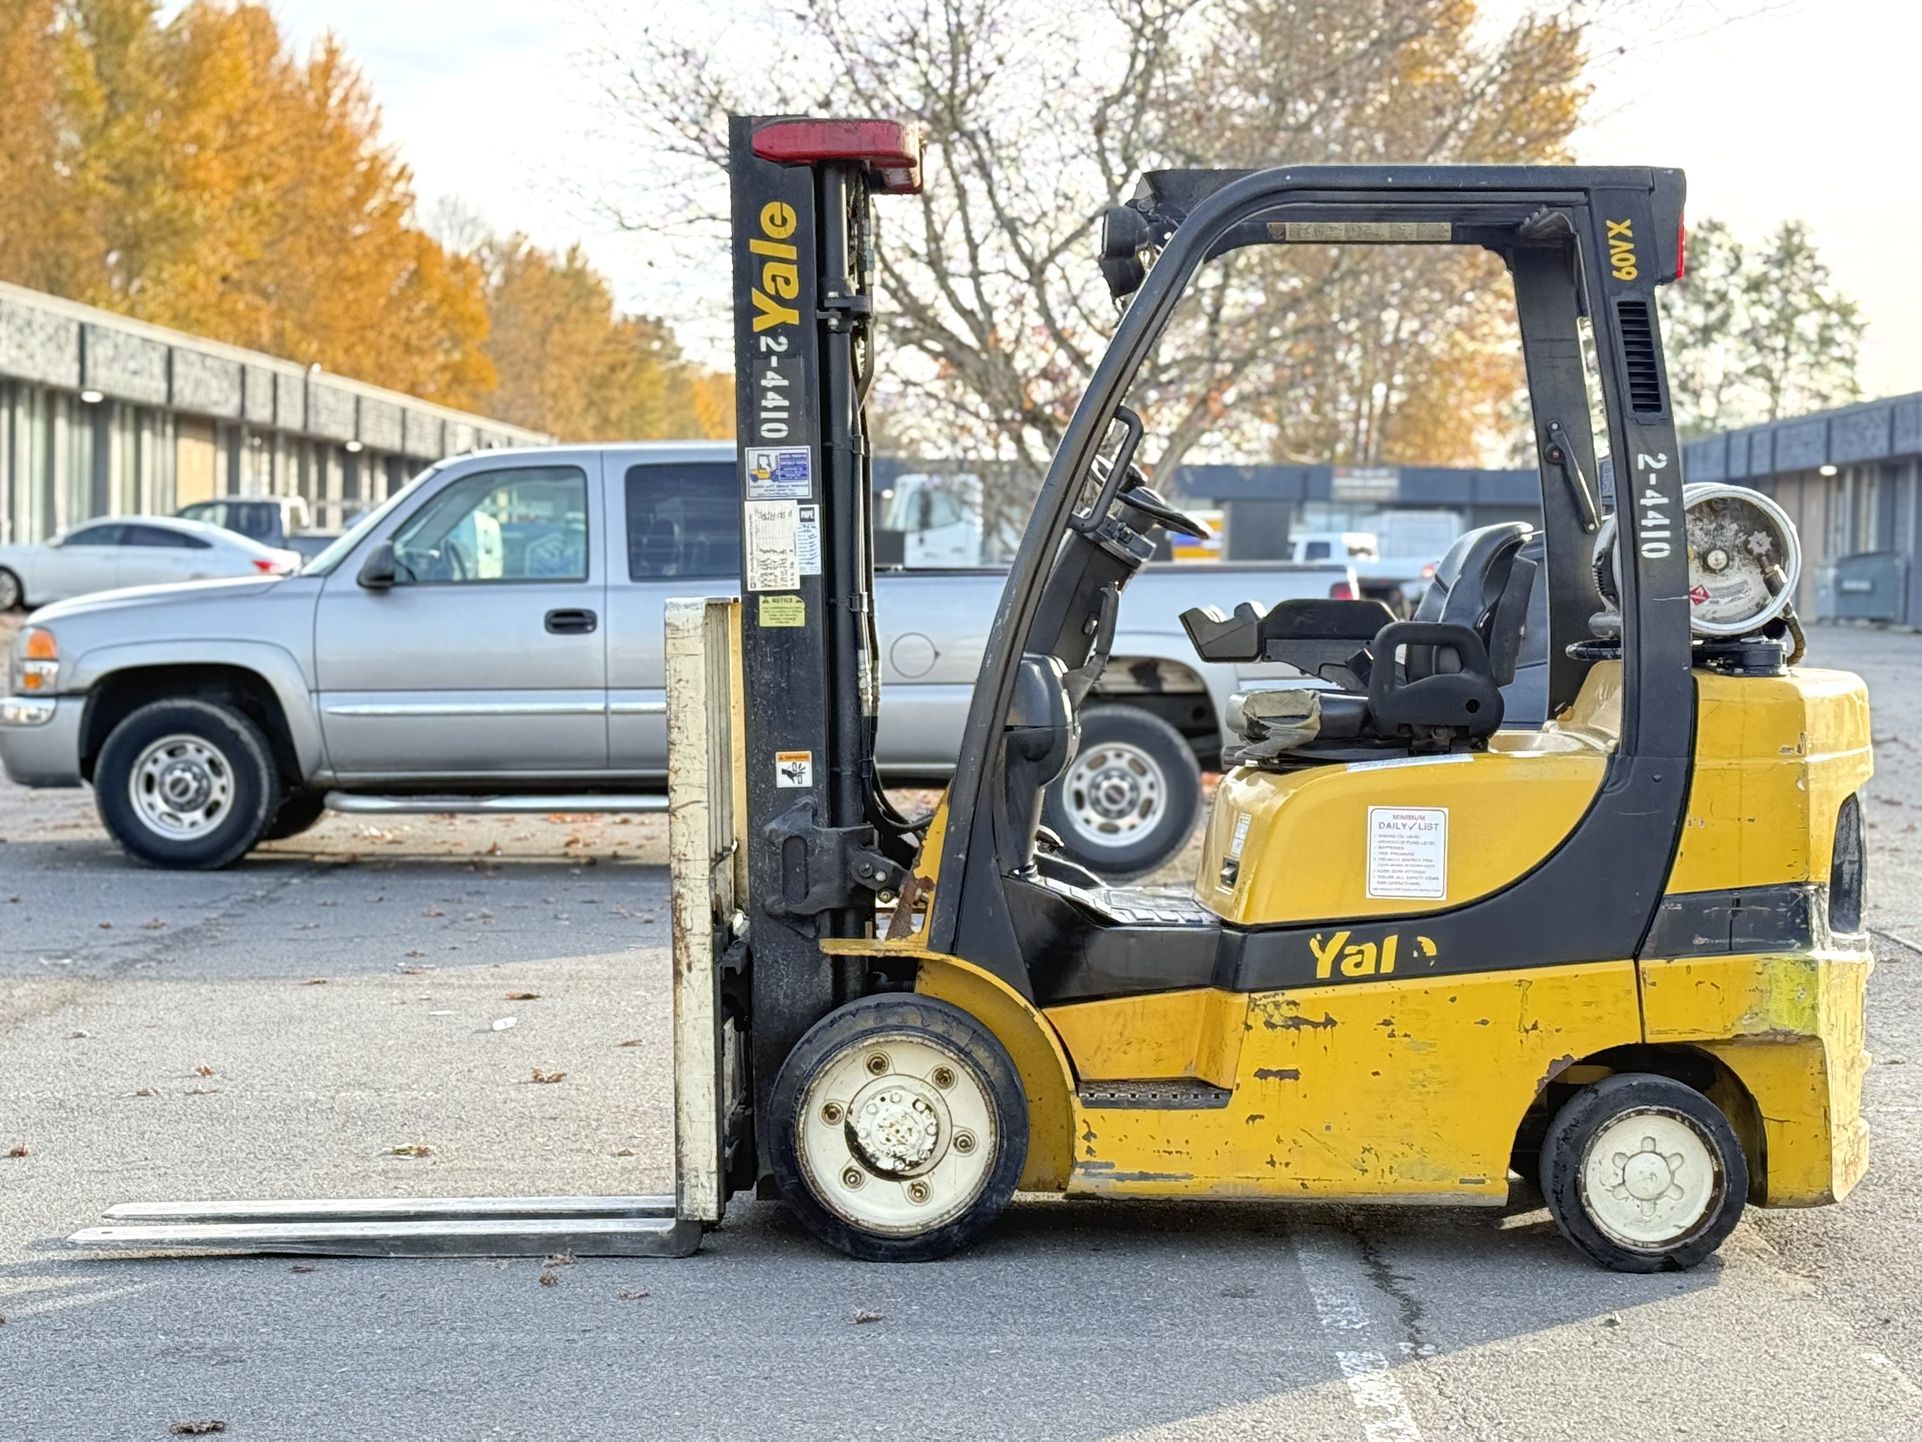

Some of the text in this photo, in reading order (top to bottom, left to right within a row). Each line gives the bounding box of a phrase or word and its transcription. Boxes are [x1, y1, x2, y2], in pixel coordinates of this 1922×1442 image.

[749, 200, 800, 333] Yale
[1605, 218, 1638, 281] 60VX
[759, 334, 790, 439] 2-4410
[1637, 452, 1672, 559] 2-4410
[1378, 821, 1440, 832] DAILY LIST
